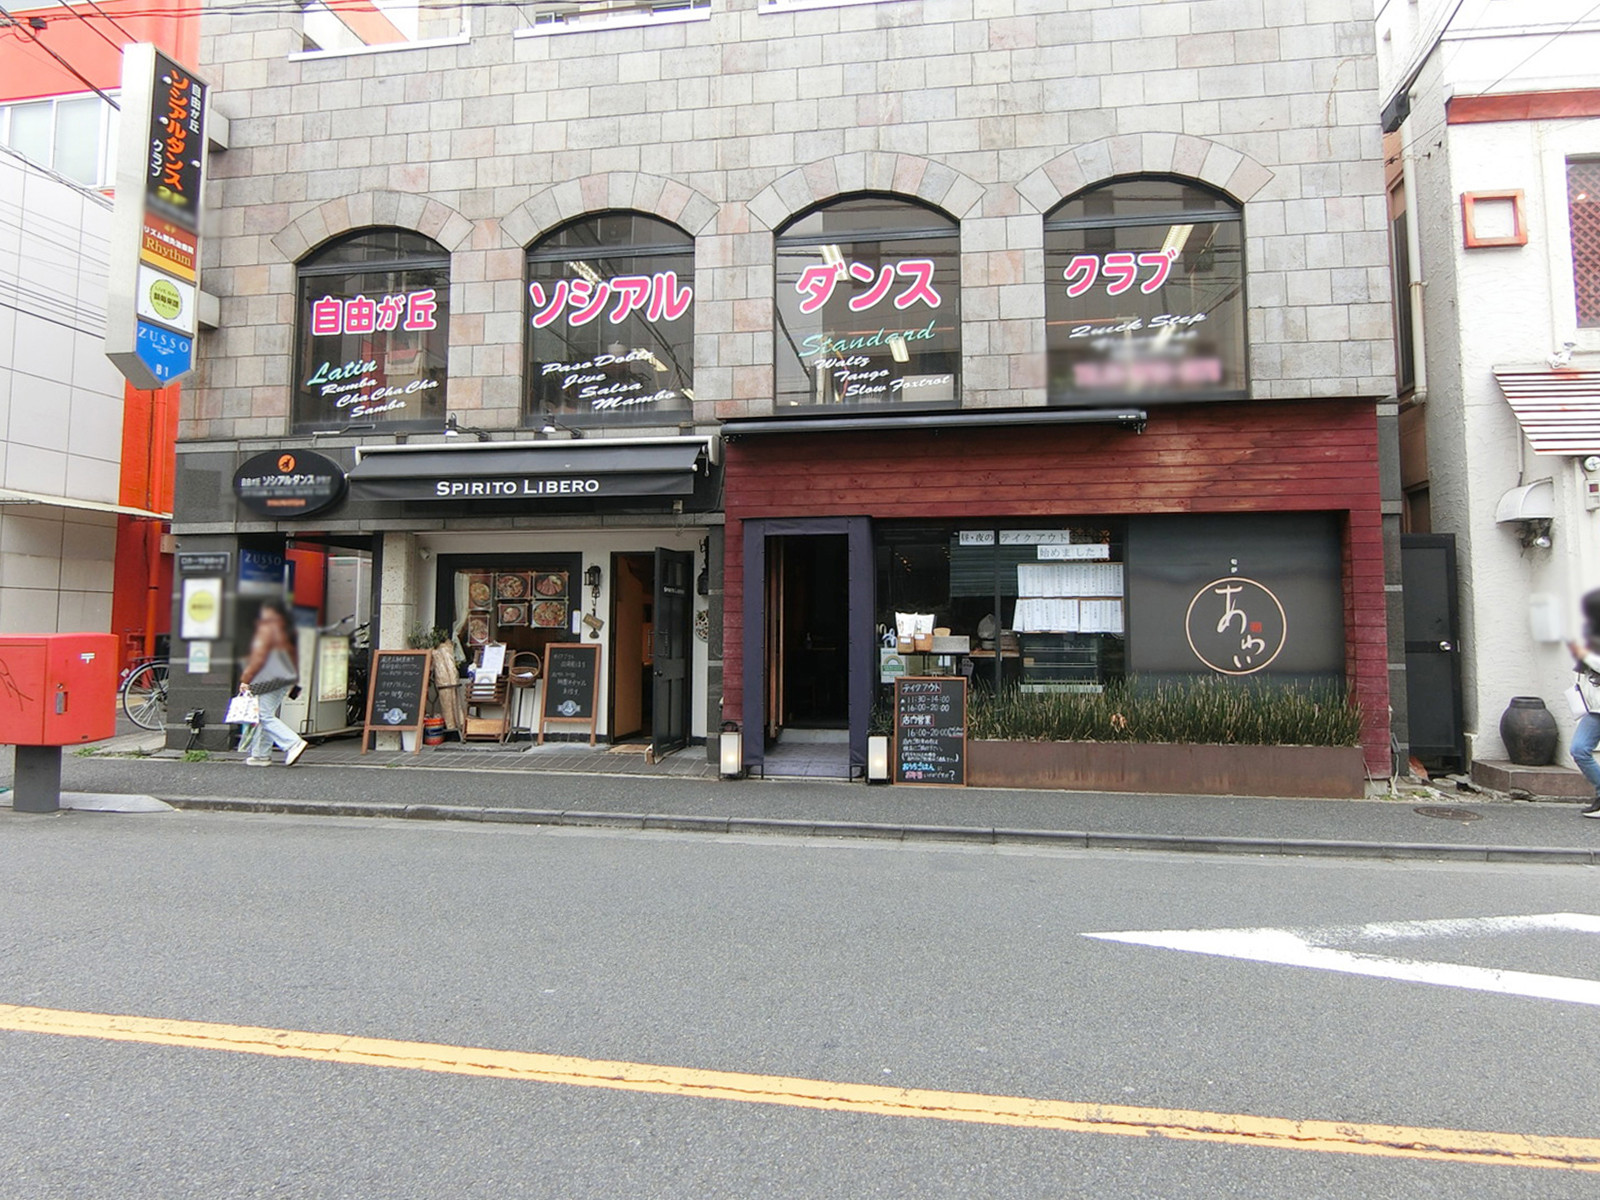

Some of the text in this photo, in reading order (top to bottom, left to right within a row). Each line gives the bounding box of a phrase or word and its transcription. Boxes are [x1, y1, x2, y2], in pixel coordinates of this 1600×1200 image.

[164, 69, 190, 191] ソシアルダンス
[151, 139, 163, 177] クラブ
[146, 236, 191, 266] Rhythm
[1063, 246, 1178, 298] クラブ
[795, 259, 942, 315] ダンス
[529, 271, 693, 329] ソシアル
[312, 289, 437, 336] 自由が丘
[1147, 312, 1208, 329] Step
[138, 327, 189, 353] ZUSSO
[799, 320, 936, 357] Standard
[156, 363, 169, 377] B1
[541, 360, 593, 376] Paso
[813, 355, 871, 370] Waltz
[306, 360, 378, 386] Latin
[561, 371, 607, 389] Jive
[833, 368, 891, 383] Tango
[321, 377, 378, 397] Rumba
[578, 382, 644, 398] Salsa
[845, 375, 951, 397] Slow Foxtrot
[350, 398, 407, 418] Samba
[591, 389, 677, 410] Mambo
[262, 474, 315, 486] ソシアルダンス
[1001, 532, 1068, 542] テイクアウト
[1039, 546, 1105, 557] 始めました！
